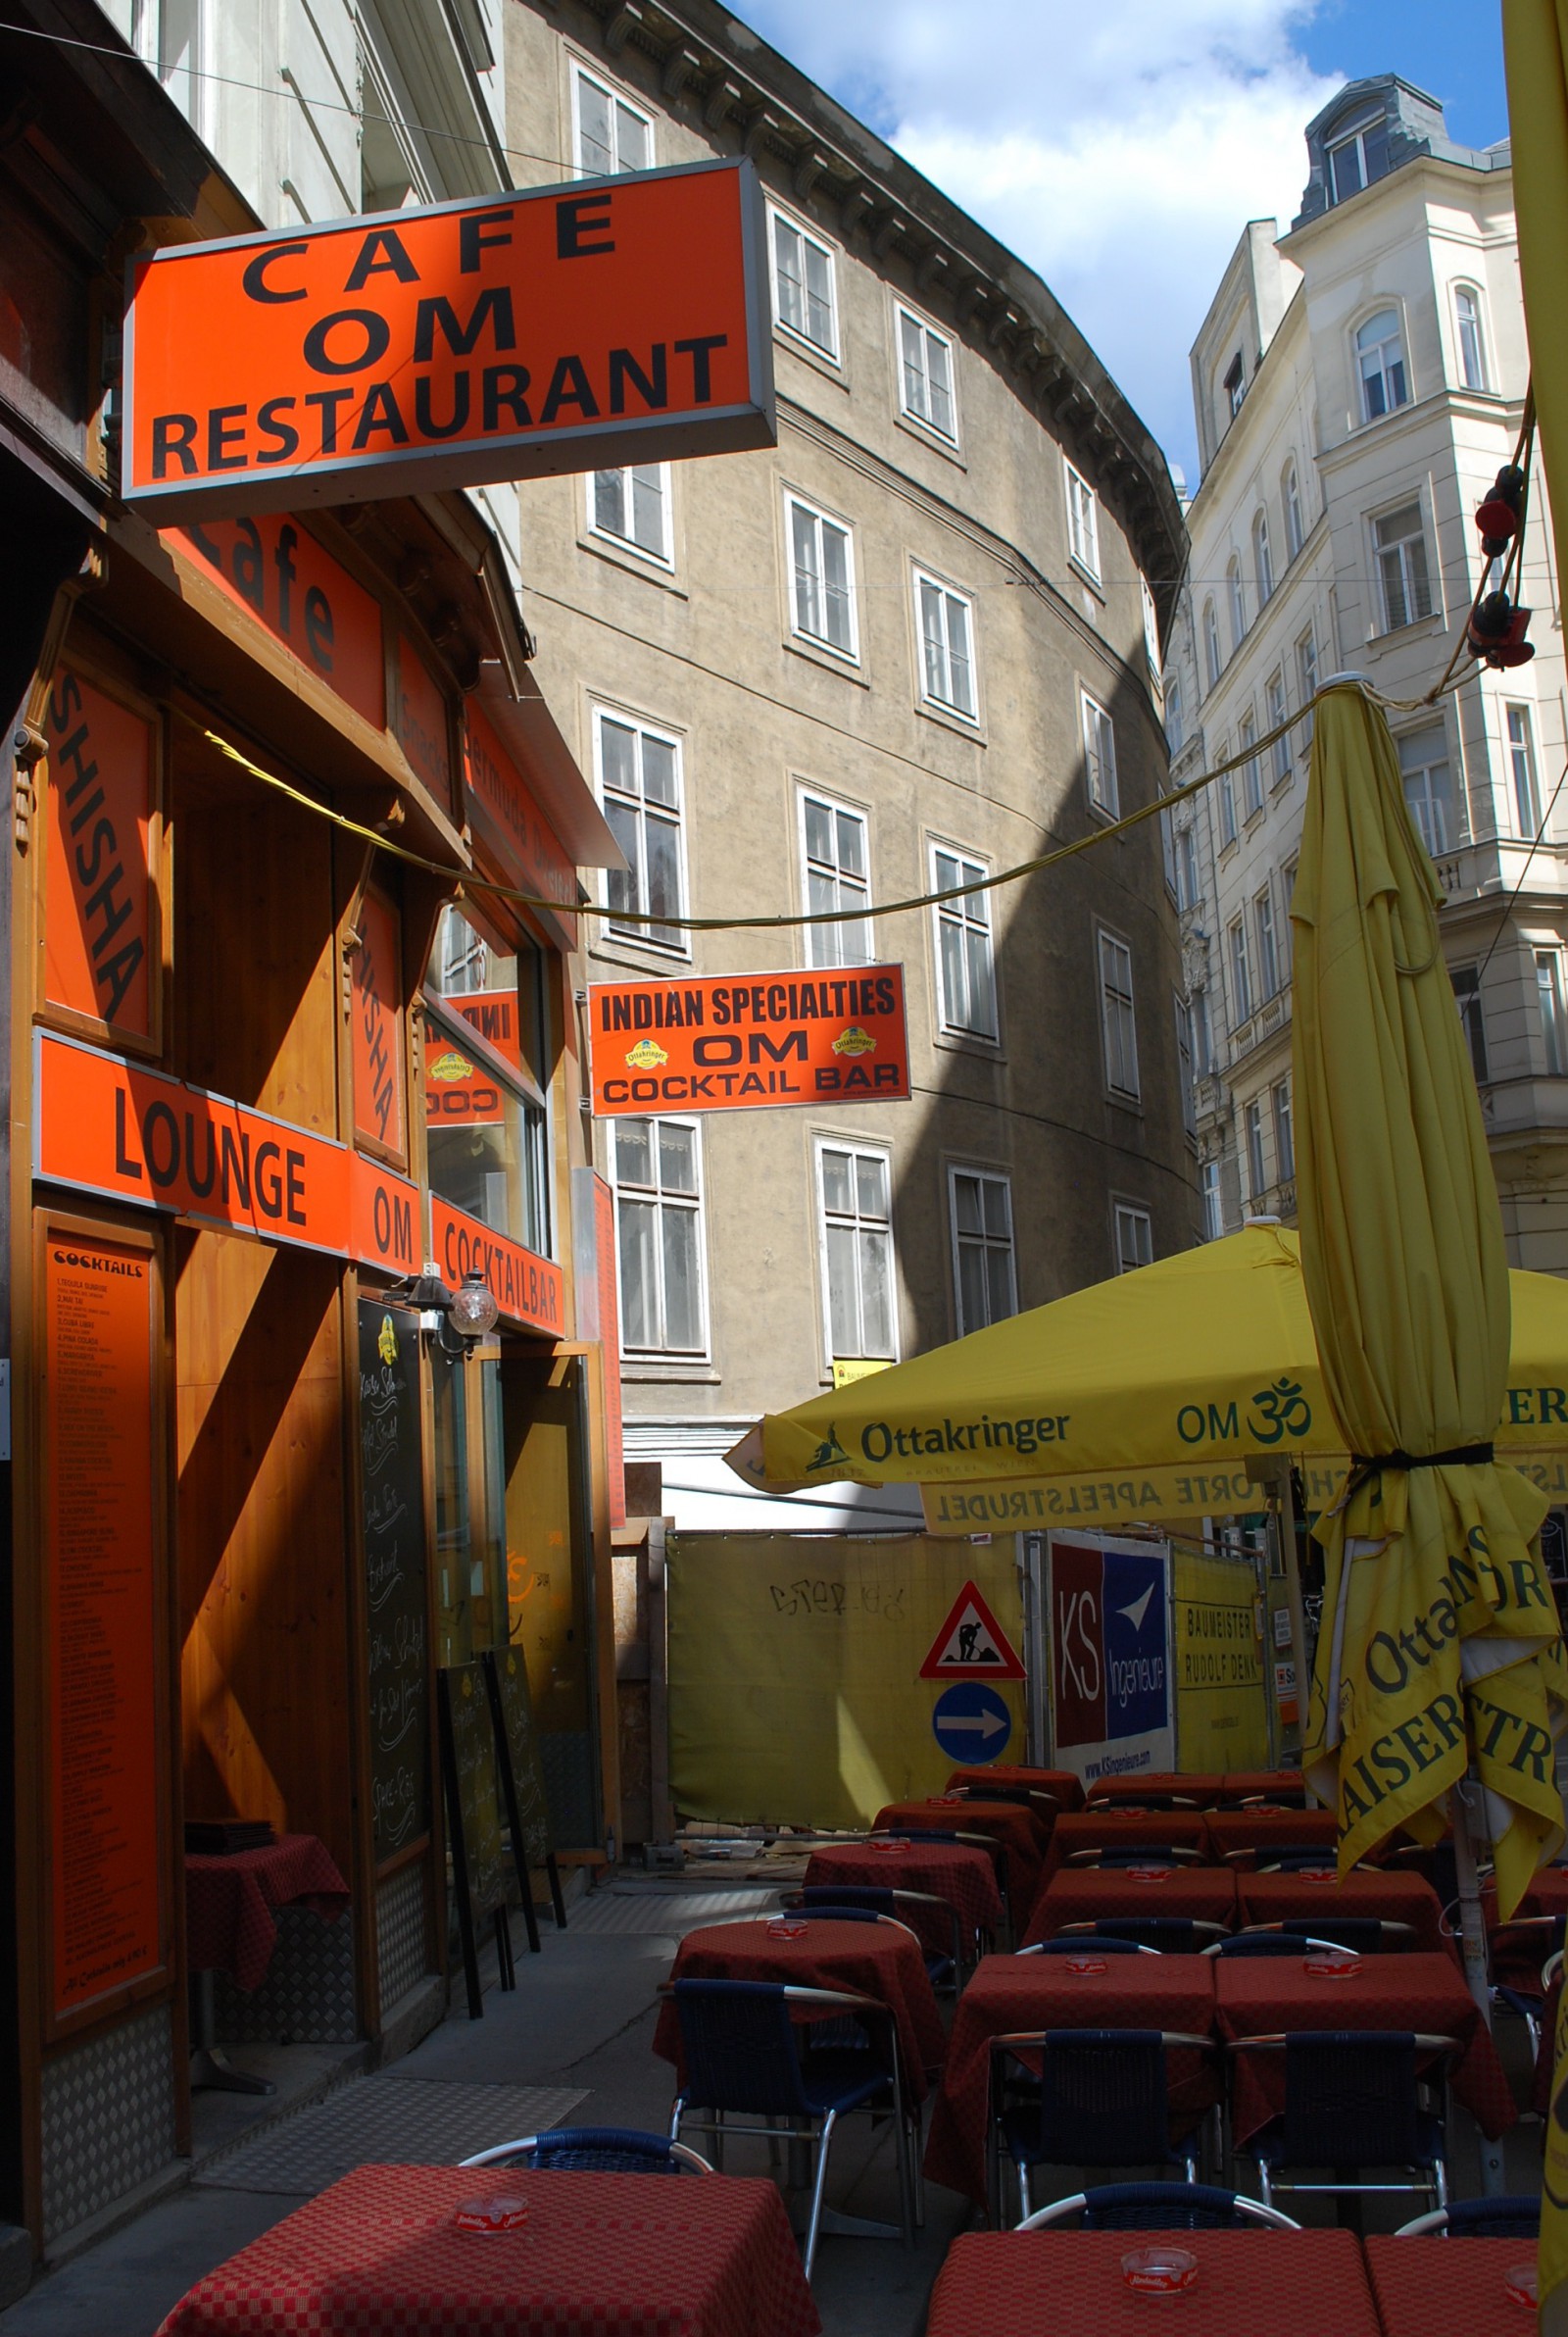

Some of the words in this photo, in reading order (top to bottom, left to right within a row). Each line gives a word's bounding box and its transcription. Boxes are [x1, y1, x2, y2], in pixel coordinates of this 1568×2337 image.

[242, 194, 615, 304] CAFE
[303, 287, 516, 375] OM
[152, 334, 728, 479] RESTAURANT
[51, 672, 145, 1023] SHISHA
[359, 907, 394, 1141] HISHA
[602, 989, 704, 1031] INDIAN
[711, 976, 896, 1025] SPECIALTIES
[692, 1030, 809, 1067] OM
[603, 1070, 801, 1104] COCKTAIL
[814, 1063, 900, 1092] BAR
[115, 1087, 308, 1227] LOUNGE
[373, 1185, 414, 1265] OM
[53, 1250, 143, 1278] COCKTAILS
[444, 1221, 558, 1323] COCKTAILBAR
[861, 1411, 1071, 1464] Ottakringer
[1177, 1401, 1242, 1444] OM
[1059, 1590, 1101, 1702] KS
[1188, 1608, 1251, 1639] BAUMEISTER
[1108, 1647, 1164, 1709] Ingenieure
[1185, 1654, 1227, 1683] RUDOLF
[1231, 1653, 1258, 1681] DENK
[1084, 1749, 1152, 1781] www.KSingenieure.com
